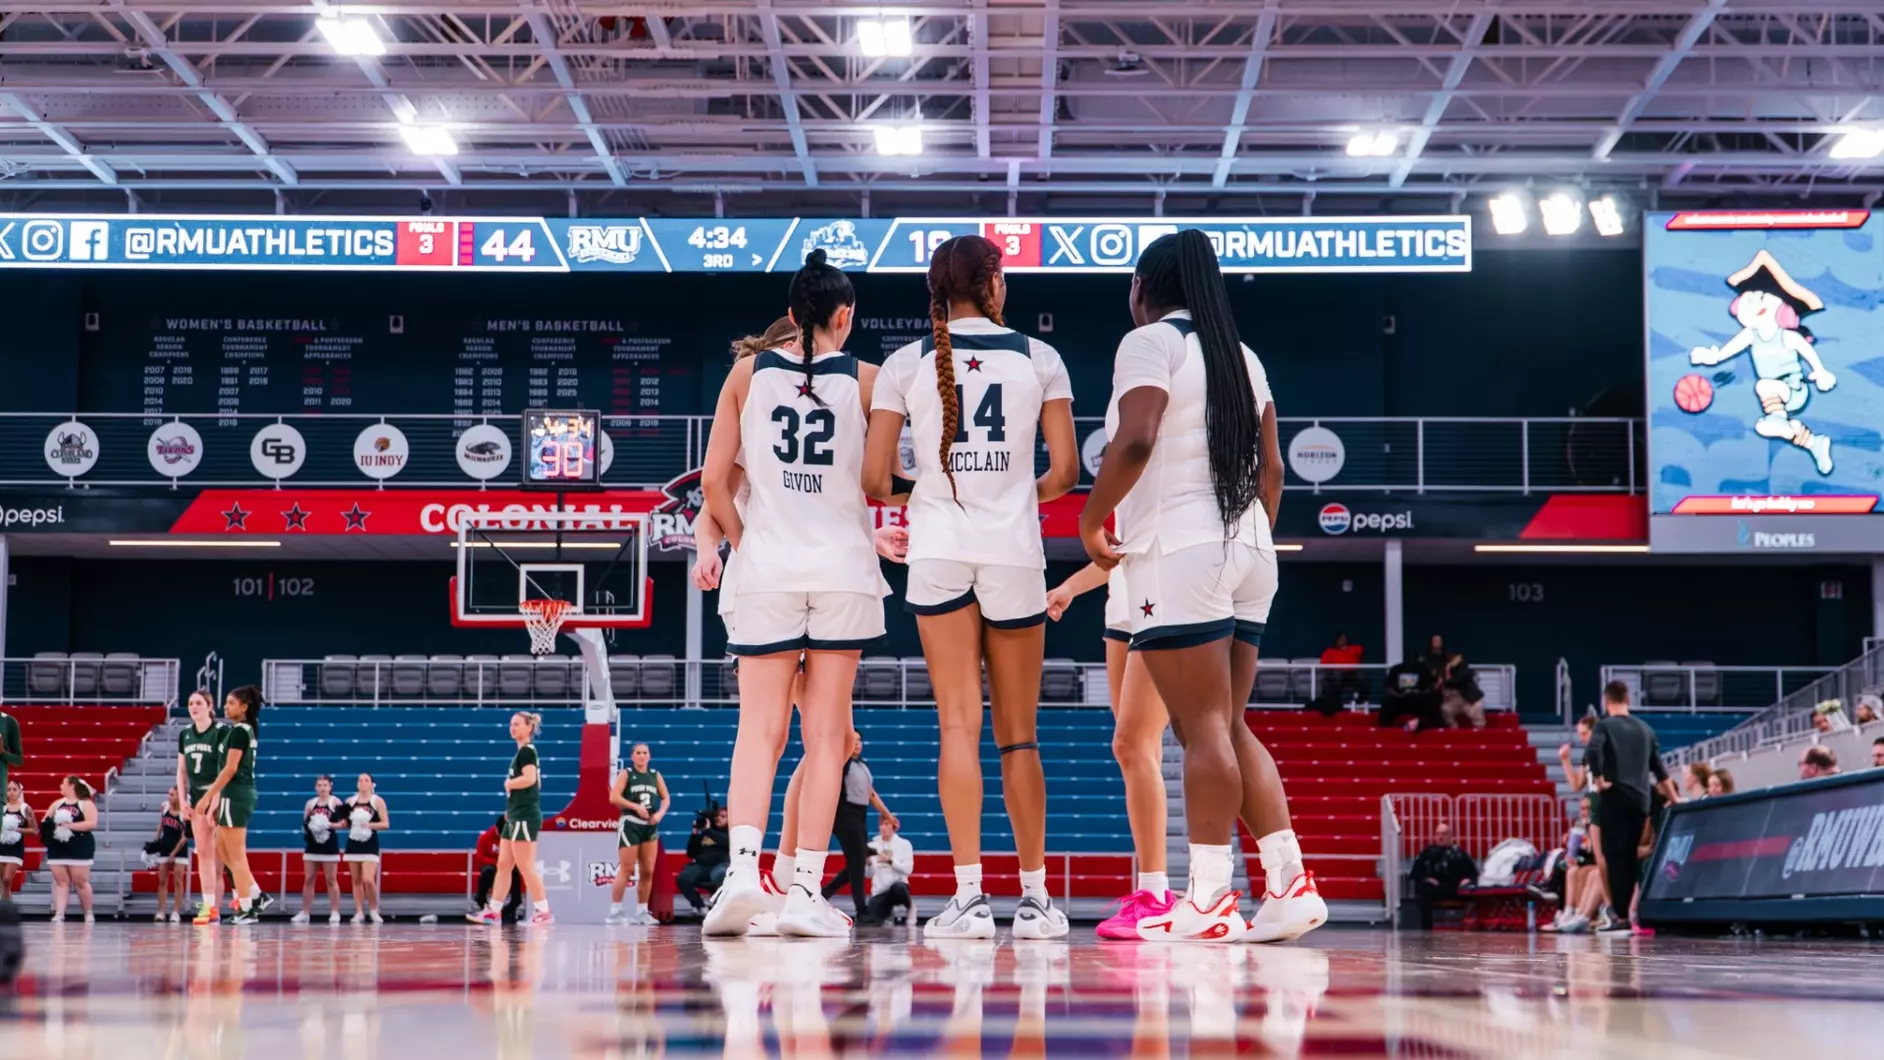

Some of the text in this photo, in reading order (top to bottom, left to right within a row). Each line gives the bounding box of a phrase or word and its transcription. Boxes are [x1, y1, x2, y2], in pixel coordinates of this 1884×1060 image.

[126, 227, 395, 261] @RMUATHLETICS
[418, 235, 434, 254] 3
[570, 227, 640, 255] RMU
[688, 226, 748, 249] 4:34
[480, 229, 535, 261] 44
[1004, 235, 1020, 256] 3
[703, 254, 733, 268] 3RD
[166, 318, 327, 332] WOMEN'S BASKETBALL
[487, 319, 624, 333] MEN'S BASKETBALL
[861, 317, 932, 331] VOLLEYBA
[144, 366, 165, 375] 2007
[249, 366, 268, 375] 2017
[556, 377, 578, 387] 2020
[640, 377, 660, 386] 2012
[144, 387, 164, 395] 2010
[218, 387, 239, 396] 2007
[303, 387, 323, 396] 2010
[640, 387, 660, 396] 2013
[143, 397, 163, 406] 2014
[303, 397, 322, 406] 2011
[330, 397, 352, 406] 2020
[481, 398, 502, 407] 2014
[640, 398, 660, 407] 2014
[953, 382, 1006, 443] 14
[770, 405, 835, 467] 32
[262, 438, 295, 464] GB
[360, 455, 403, 466] IU INDY
[946, 450, 1011, 472] MCCLAIN
[783, 470, 823, 495] GIVON
[5, 505, 62, 527] pepsi
[420, 503, 634, 533] COLONIAL
[1353, 510, 1412, 533] pepsi
[652, 513, 699, 541] RM
[665, 535, 697, 545] COLON
[1754, 531, 1815, 548] PEOPLES
[233, 578, 314, 597] 101 102
[1508, 583, 1545, 602] 103
[190, 753, 203, 774] 7
[569, 817, 619, 829] Clearvie
